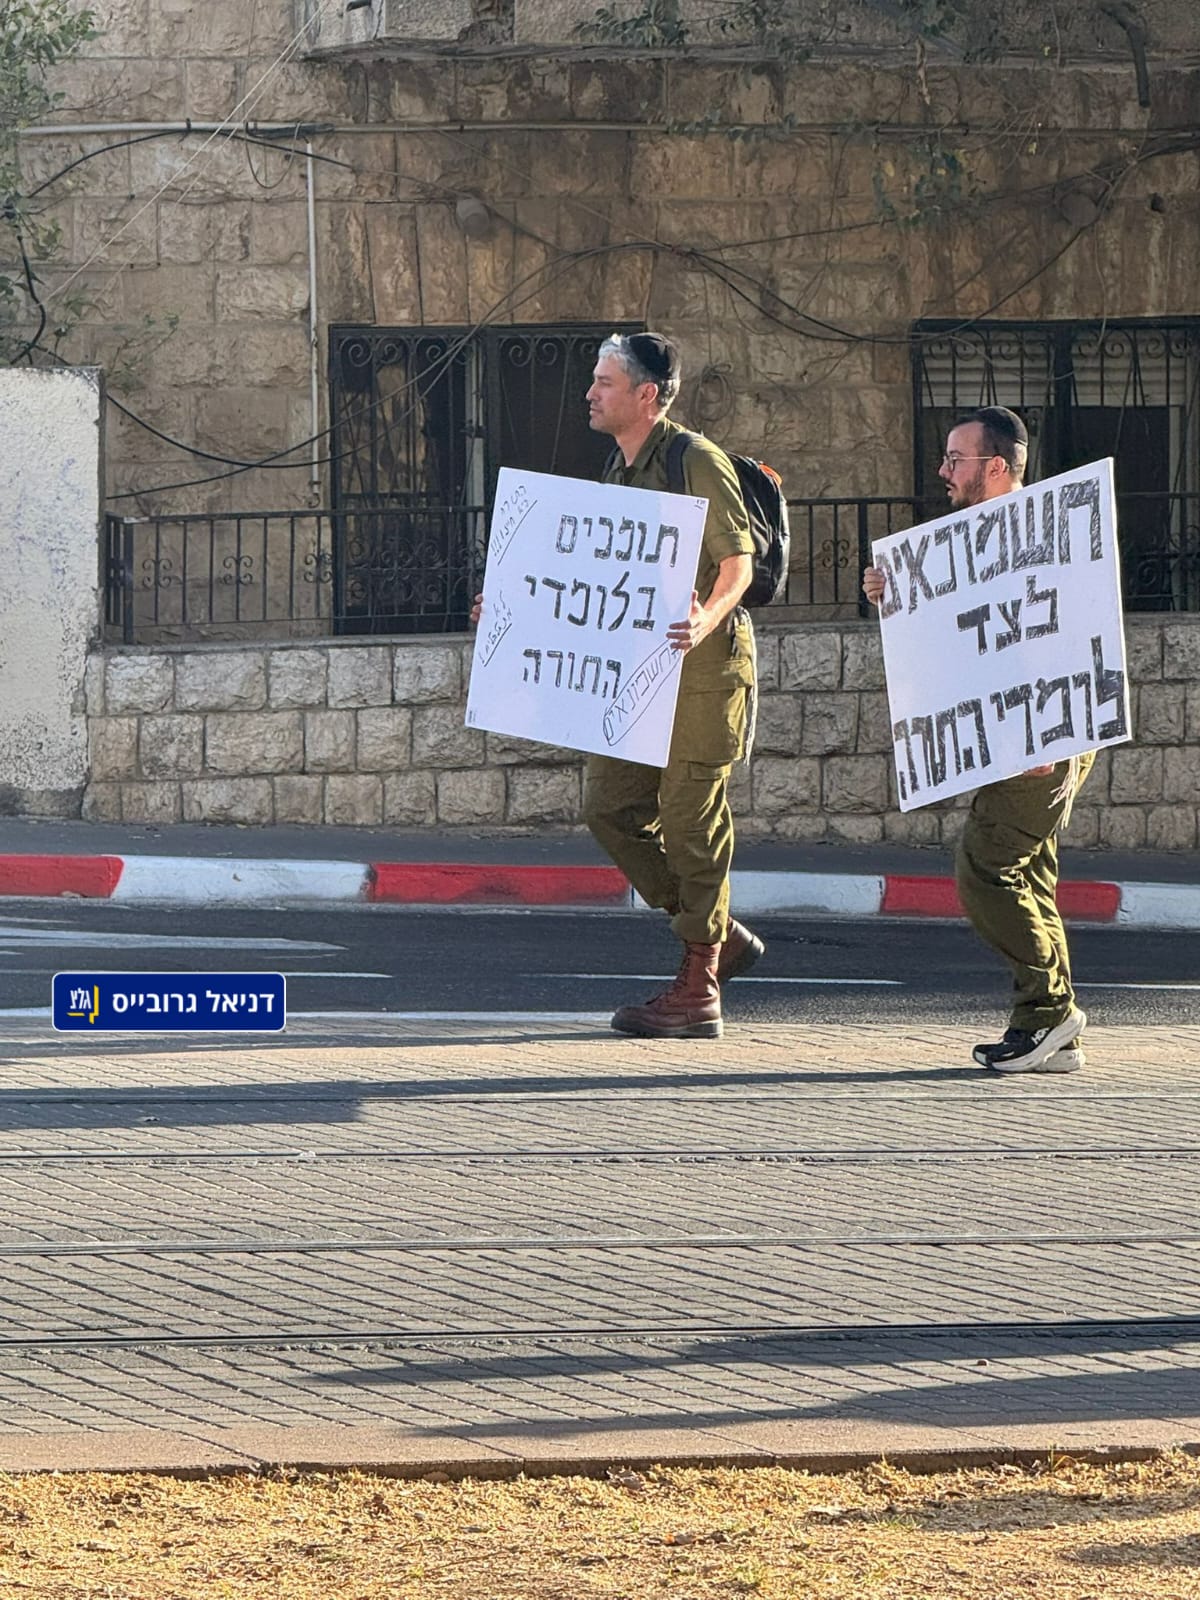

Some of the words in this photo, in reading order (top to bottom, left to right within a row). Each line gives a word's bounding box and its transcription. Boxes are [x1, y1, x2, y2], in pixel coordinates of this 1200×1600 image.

[556, 514, 679, 567] תומכים
[524, 571, 656, 632] בלומדי
[957, 574, 1059, 656] לצד
[522, 648, 622, 699] התורה
[989, 635, 1127, 755] לומדי
